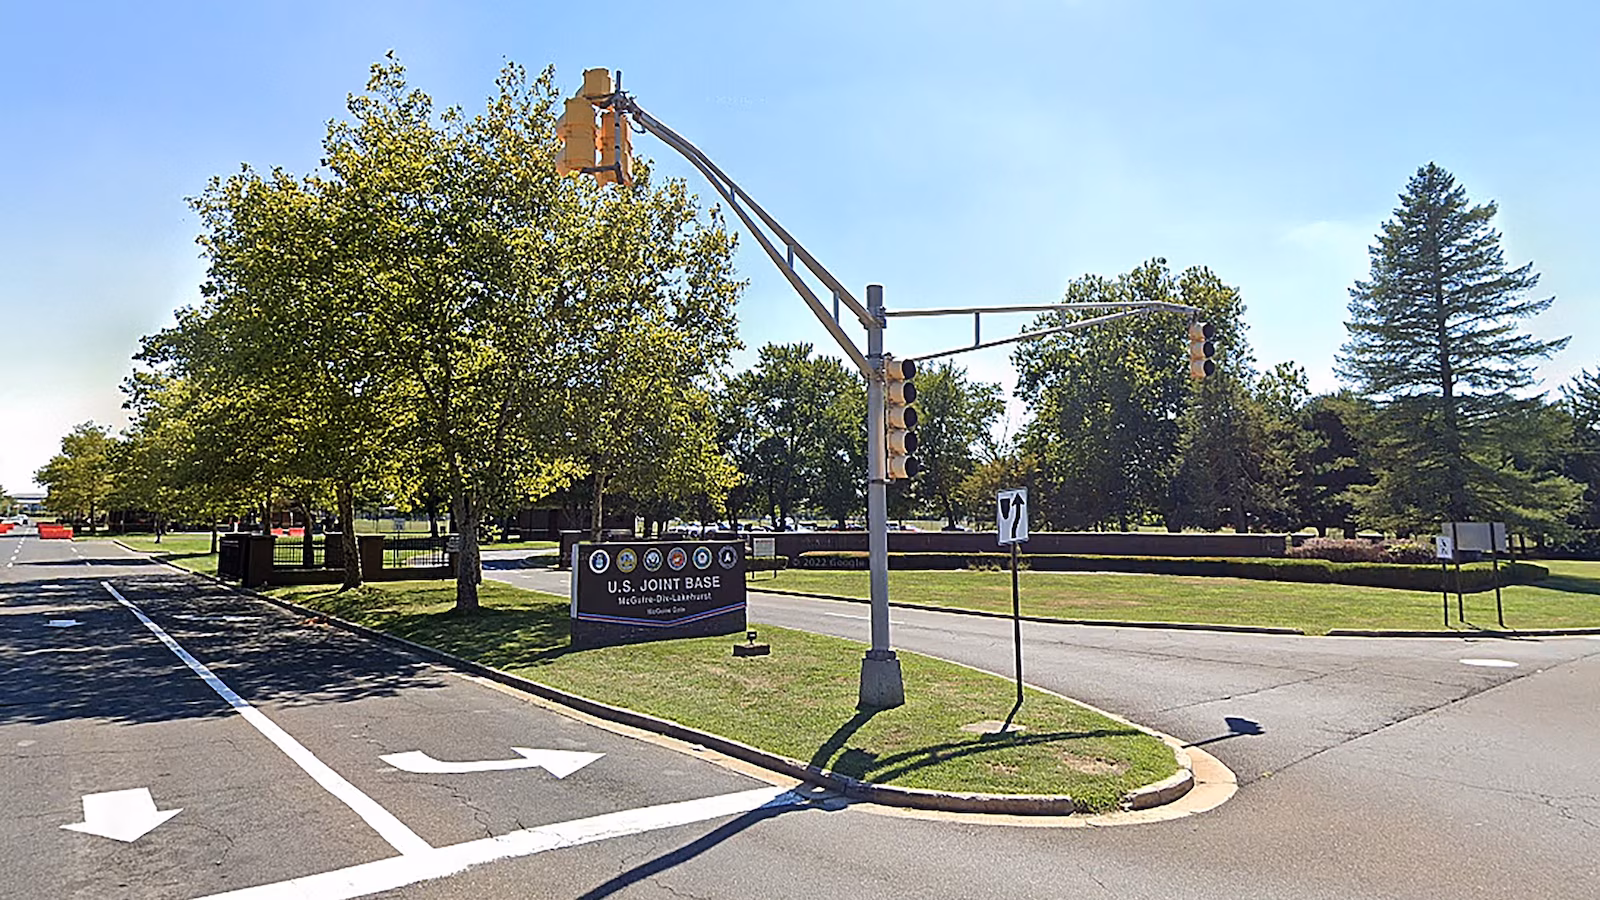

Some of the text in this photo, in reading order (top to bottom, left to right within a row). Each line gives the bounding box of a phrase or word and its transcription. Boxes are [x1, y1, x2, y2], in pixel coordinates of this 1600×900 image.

[608, 576, 721, 594] U.S. JOINT BASE
